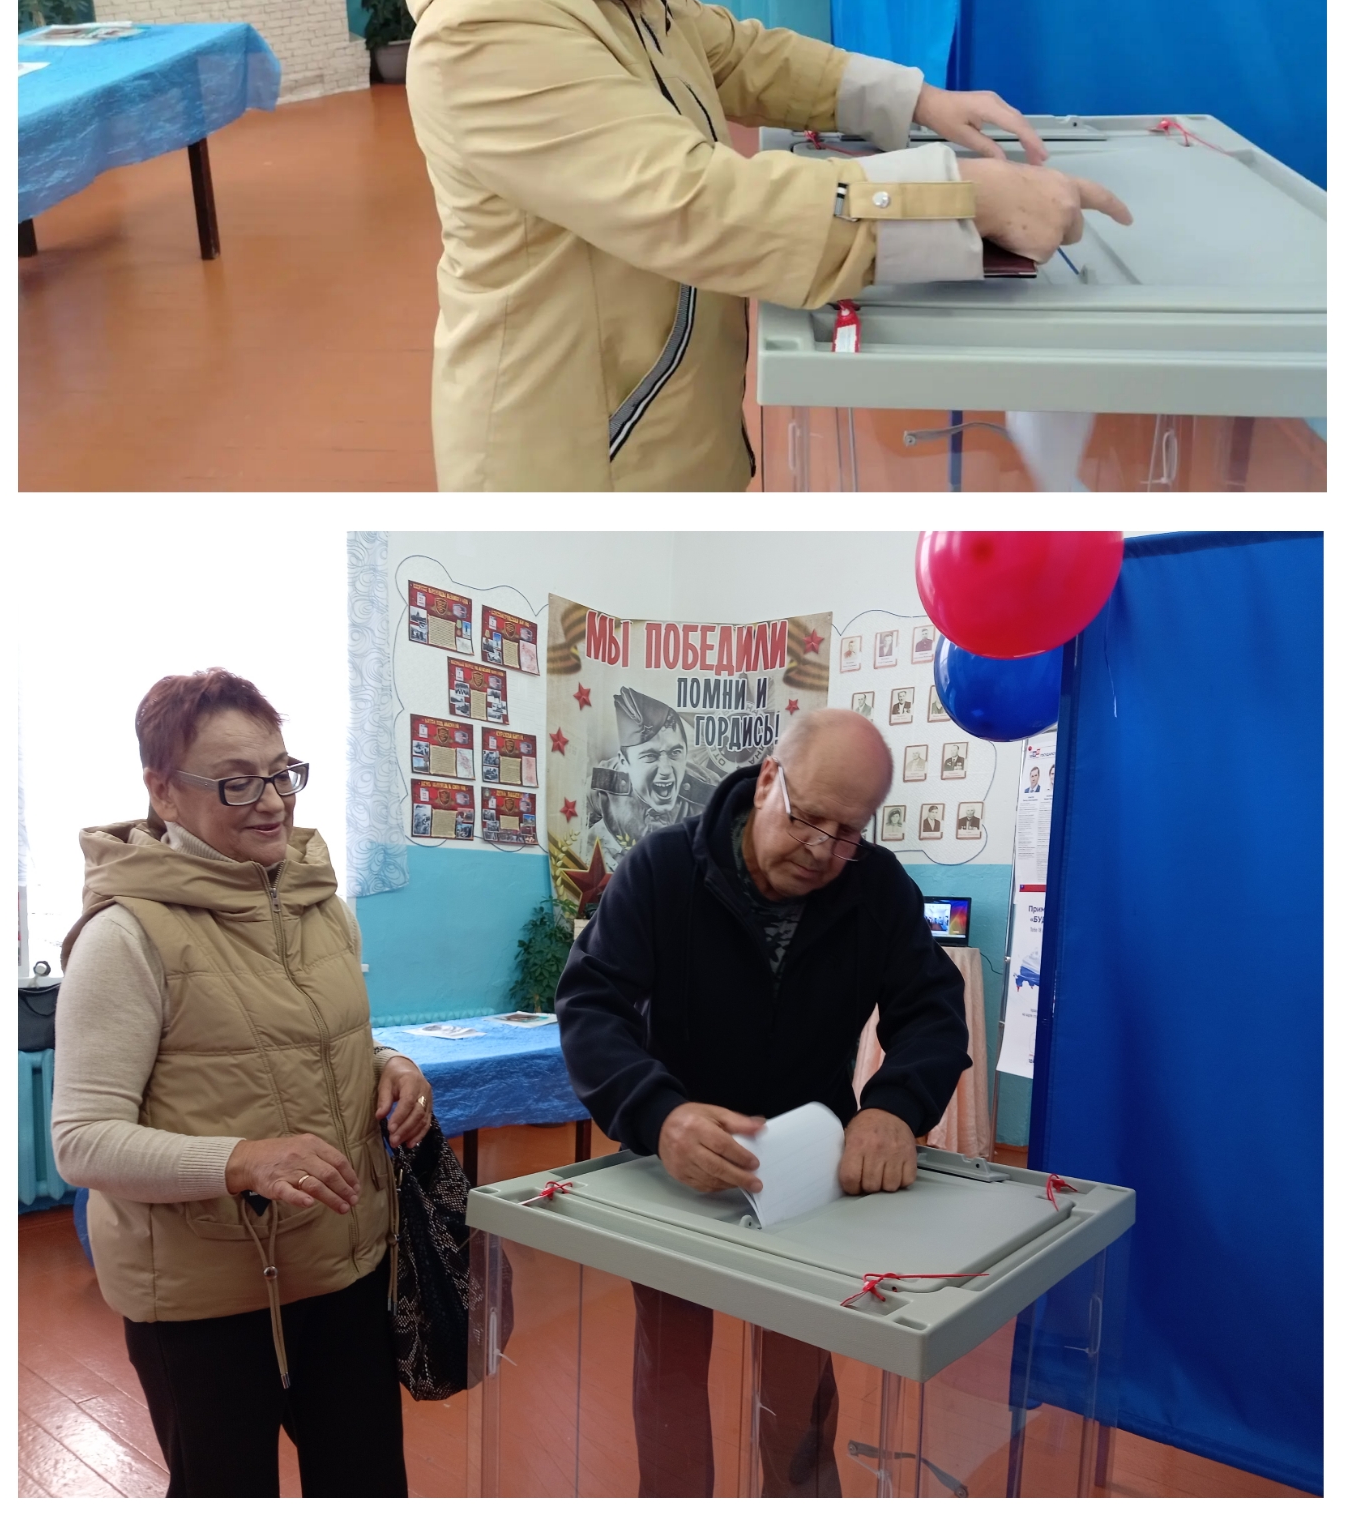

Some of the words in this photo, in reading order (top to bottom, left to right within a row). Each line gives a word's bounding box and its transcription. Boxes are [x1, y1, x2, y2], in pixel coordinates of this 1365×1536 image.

[586, 610, 631, 668] МЫ
[644, 620, 788, 677] ПОБЕДИЛИ
[676, 677, 746, 710] ПОМНИ
[756, 677, 768, 709] И
[694, 712, 781, 751] ГОРДИСЬ!
